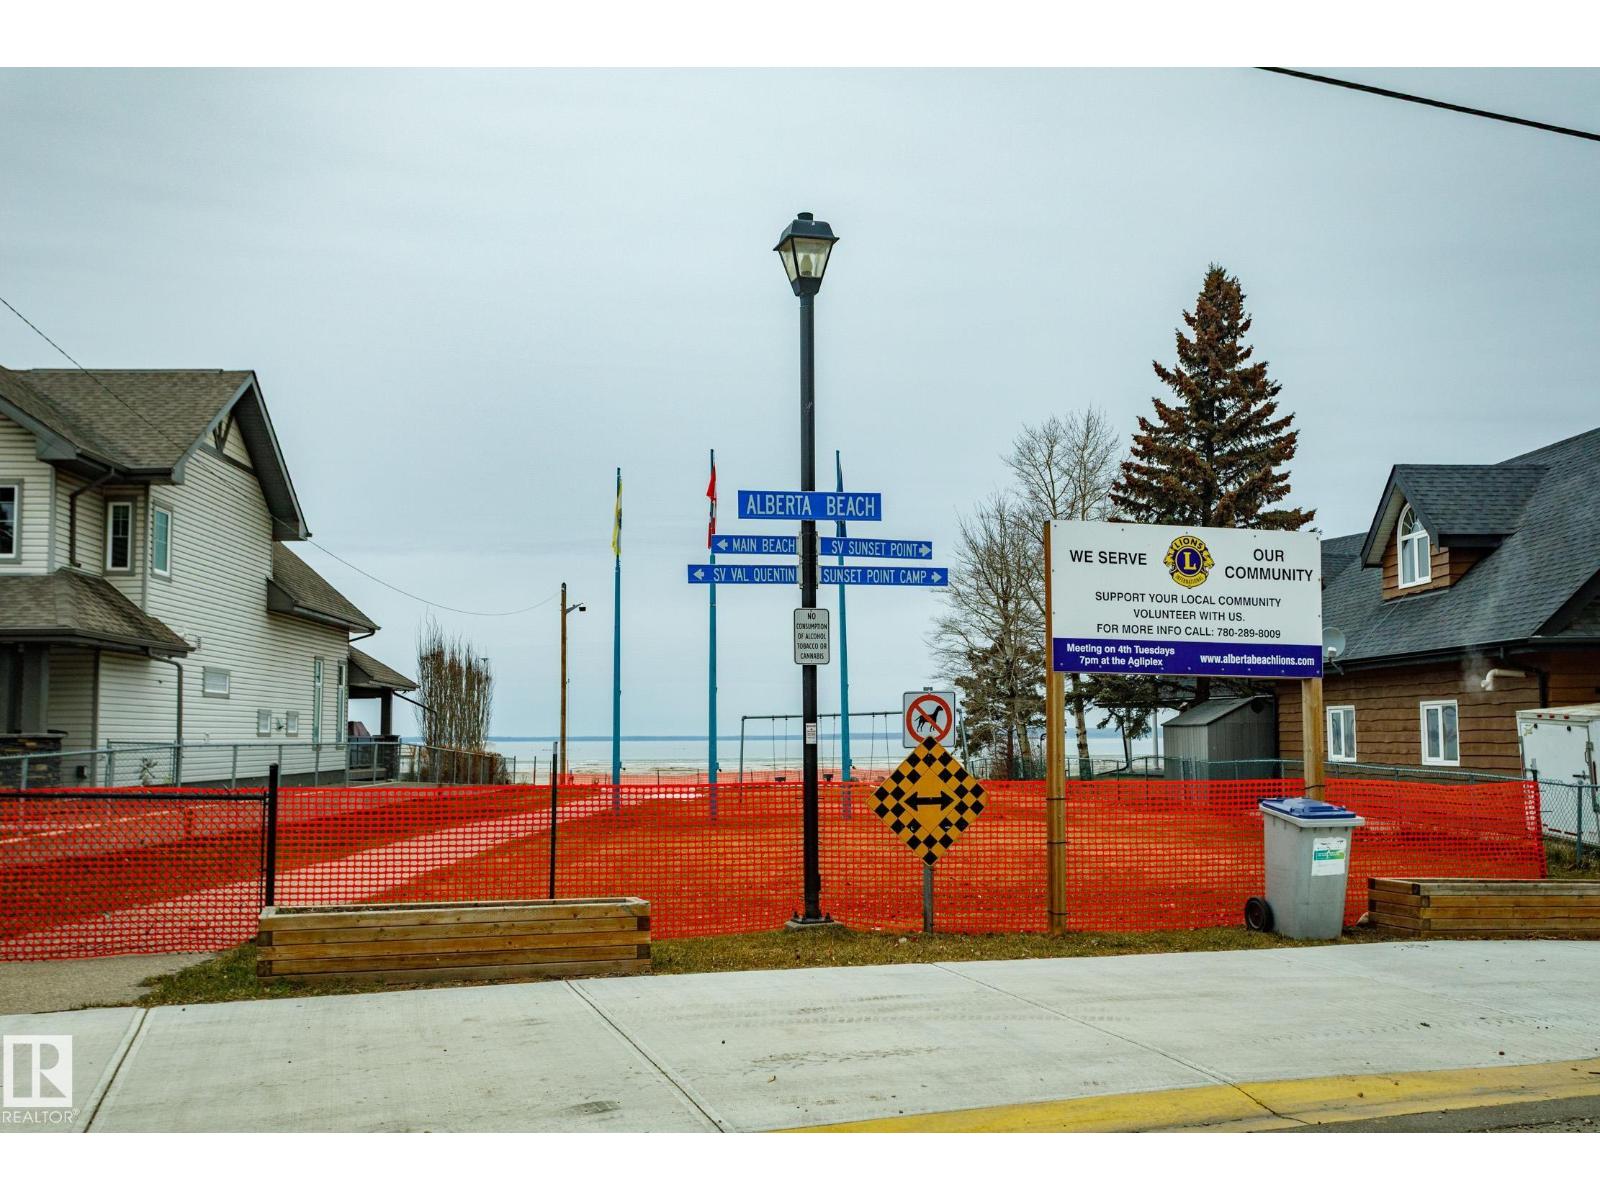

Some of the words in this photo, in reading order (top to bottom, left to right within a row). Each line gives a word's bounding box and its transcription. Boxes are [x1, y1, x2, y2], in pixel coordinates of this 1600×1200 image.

[746, 494, 812, 516] ALBERTA
[826, 495, 875, 517] BEACH
[732, 538, 757, 552] MAIN
[762, 538, 795, 553] BEACH
[831, 540, 844, 554] SV
[848, 541, 886, 556] SUNSET
[890, 542, 918, 557] POINT
[1174, 537, 1204, 550] LIONS
[1069, 549, 1094, 563] WE
[1098, 551, 1148, 565] SERVE
[1183, 551, 1197, 570] L
[1253, 548, 1284, 562] OUR
[713, 567, 726, 582] SV
[731, 567, 749, 582] VAL
[753, 567, 795, 582] QUENTIN
[823, 568, 862, 583] SUNSET
[866, 569, 896, 583] POINT
[899, 570, 927, 584] CAMP
[1224, 566, 1313, 582] COMMUNITY
[1095, 591, 1146, 602] SUPPORT
[1149, 593, 1178, 604] YOUR
[1181, 594, 1216, 605] LOCAL
[1218, 595, 1281, 607] COMMUNITY
[807, 612, 817, 620] NO
[1133, 609, 1196, 620] VOLUNTEER
[1199, 611, 1226, 621] WITH
[1228, 612, 1245, 622] US.
[1096, 623, 1119, 634] FOR
[1122, 624, 1153, 635] MORE
[1156, 626, 1182, 636] INFO
[1184, 626, 1214, 637] CALL:
[1217, 627, 1281, 639] 780-289-8009
[1066, 643, 1102, 654] Meeting
[1104, 645, 1116, 654] on
[1117, 644, 1132, 654] 4th
[1133, 645, 1176, 657] Tuesdays
[1079, 655, 1099, 666] 7pm
[1100, 656, 1110, 665] at
[1112, 656, 1126, 666] the
[1127, 657, 1163, 668] Agliplex
[1199, 653, 1315, 667] www.albertabeachlions.com
